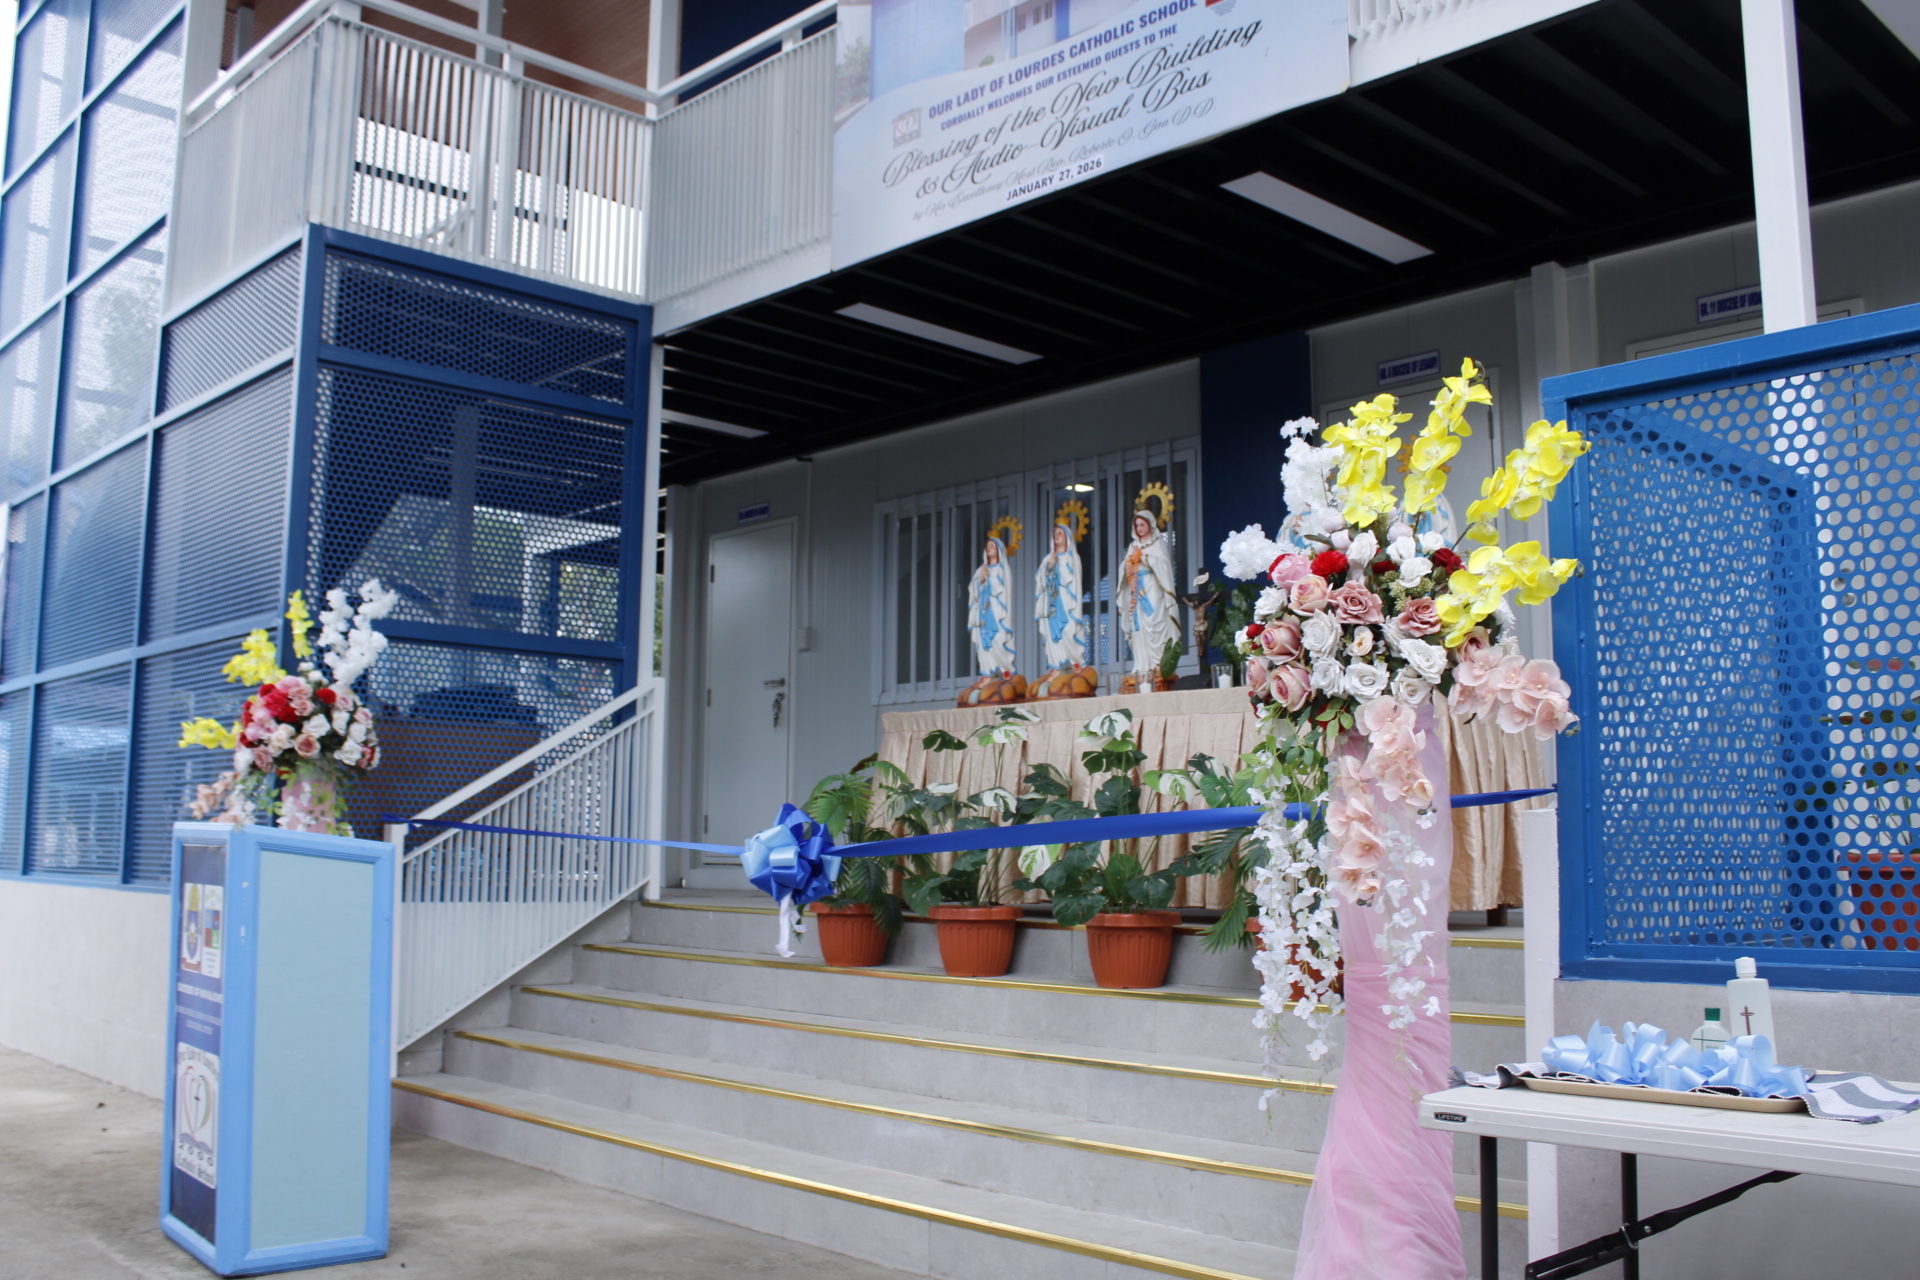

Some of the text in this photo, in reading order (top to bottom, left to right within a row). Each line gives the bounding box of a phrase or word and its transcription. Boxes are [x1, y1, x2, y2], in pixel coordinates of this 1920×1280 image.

[929, 99, 953, 119] OUR
[956, 84, 986, 107] LADY
[989, 76, 1004, 93] OF
[1008, 50, 1065, 85] LOURDES
[1069, 20, 1134, 58] CATHOLIC
[1139, 0, 1197, 28] SCHOOL
[941, 105, 985, 131] CORDIALLY
[987, 85, 1032, 111] WELCOMES
[1036, 76, 1054, 91] OUR
[1057, 56, 1102, 83] ESTEEMED
[1104, 39, 1141, 62] GUESTS
[1144, 33, 1156, 46] TO
[1159, 24, 1178, 39] THE
[882, 18, 1264, 188] Blessing of the New Building
[916, 176, 940, 199] &
[1142, 67, 1212, 114] Bus
[1006, 158, 1102, 201] JANUARY 27, 2026
[1069, 138, 1115, 163] Roberto
[1717, 295, 1739, 313] DIOCESE
[1739, 294, 1746, 309] OF
[1392, 362, 1411, 378] DIOCESE
[1412, 360, 1418, 373] OF
